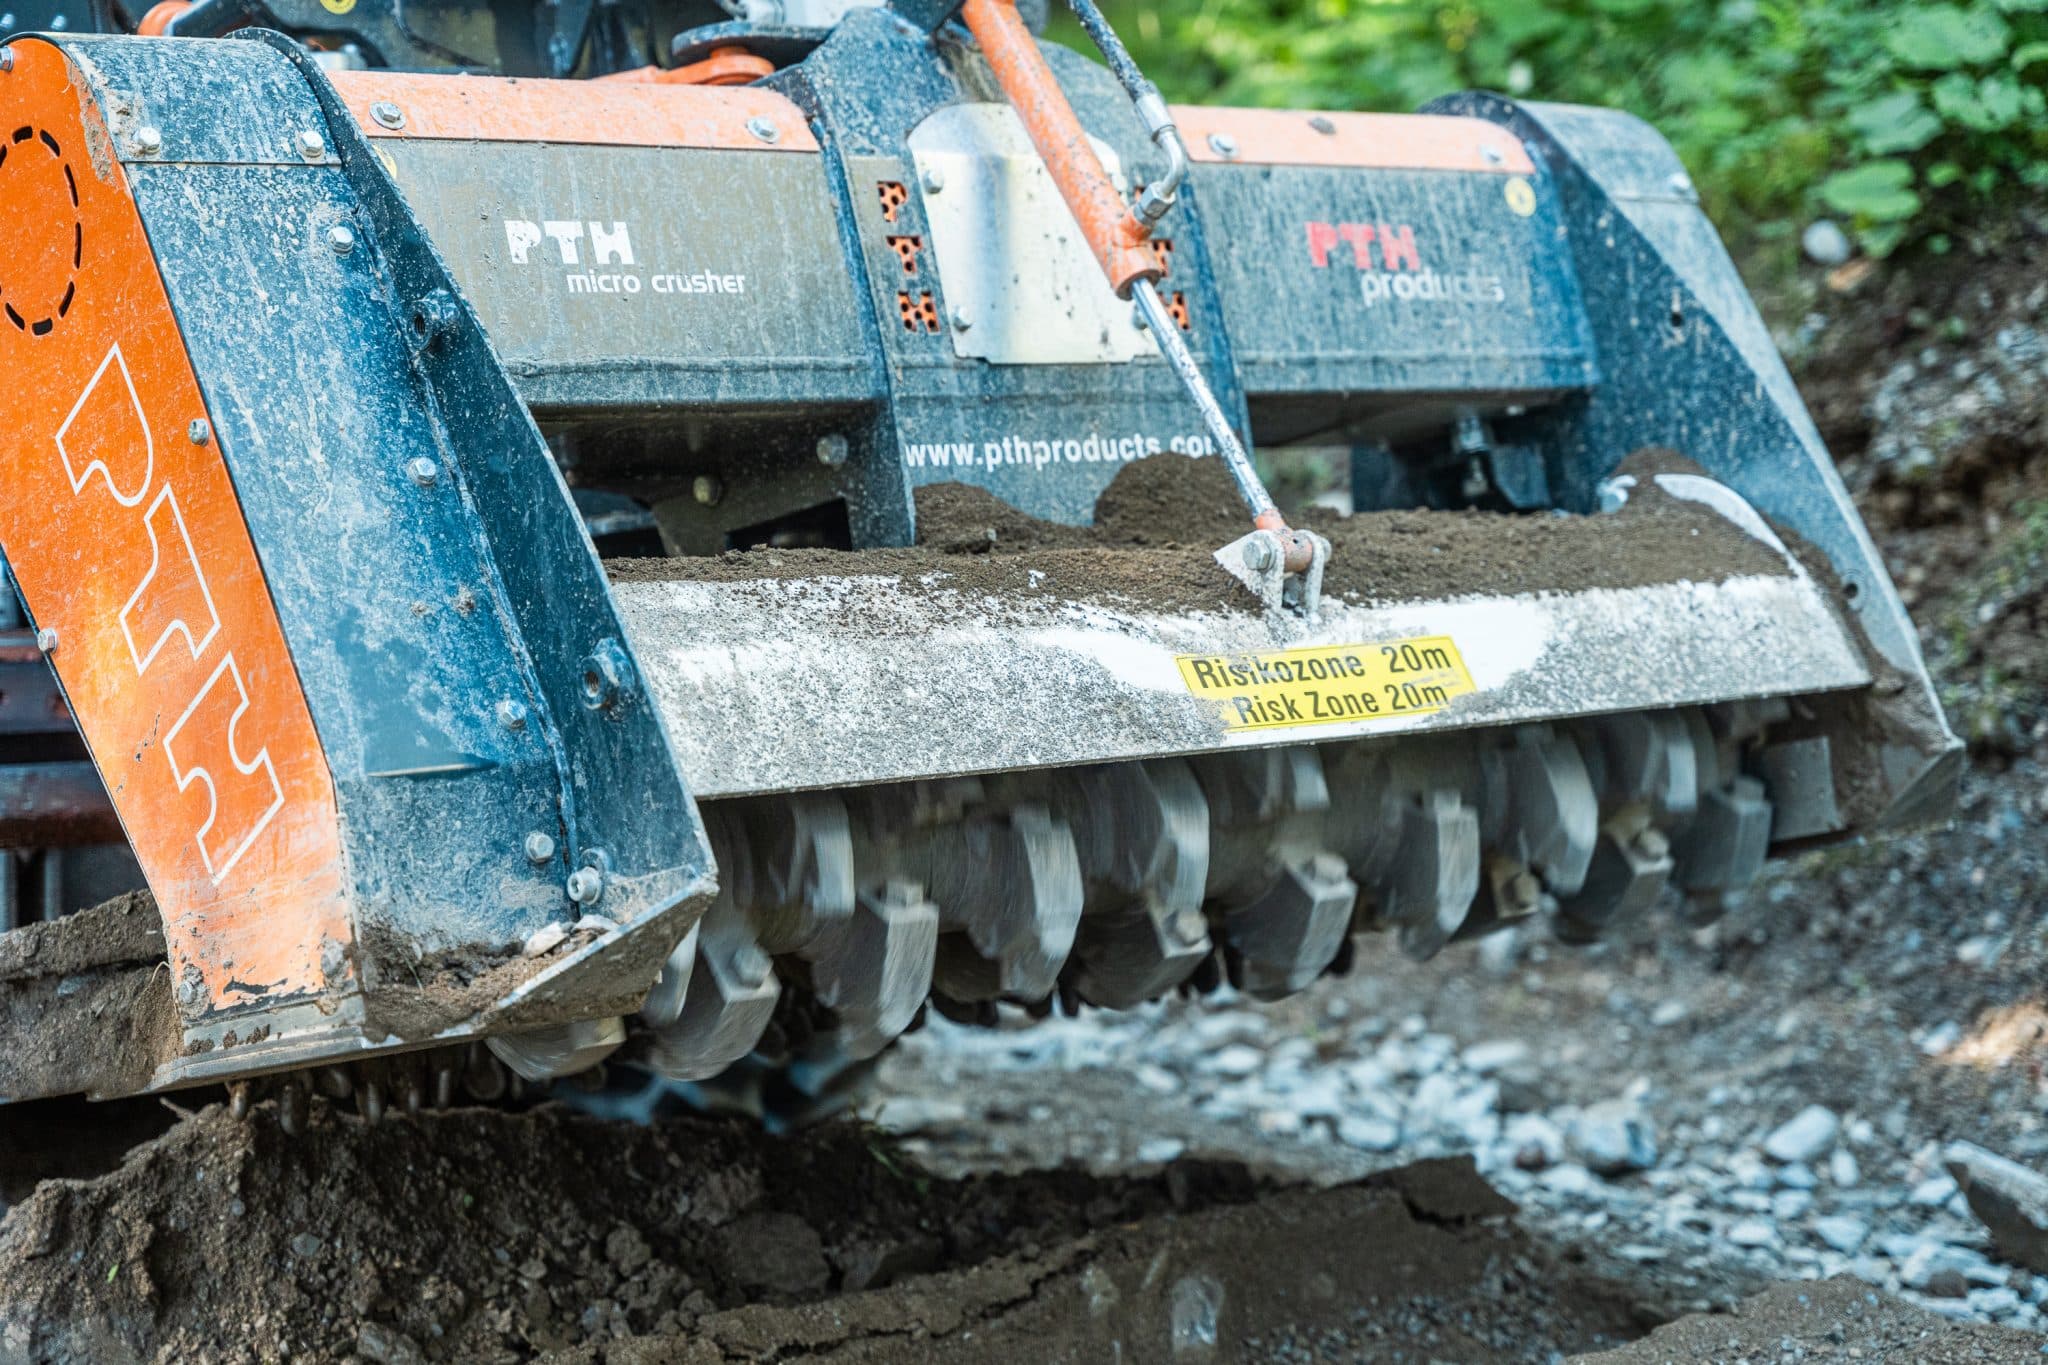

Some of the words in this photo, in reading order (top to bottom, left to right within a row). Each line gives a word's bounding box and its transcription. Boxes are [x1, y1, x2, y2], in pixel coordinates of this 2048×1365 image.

[504, 220, 636, 265] PTH
[1304, 221, 1421, 271] PTH
[566, 269, 641, 294] micro
[651, 268, 746, 294] crusher
[1360, 266, 1505, 308] products
[905, 433, 1218, 472] www.pthproductsco
[55, 341, 286, 887] PTH
[1191, 653, 1366, 690] Risikozone
[1381, 643, 1452, 674] 20m
[1232, 692, 1304, 725] Risk
[1304, 689, 1380, 719] Zone
[1384, 681, 1449, 710] 20m
